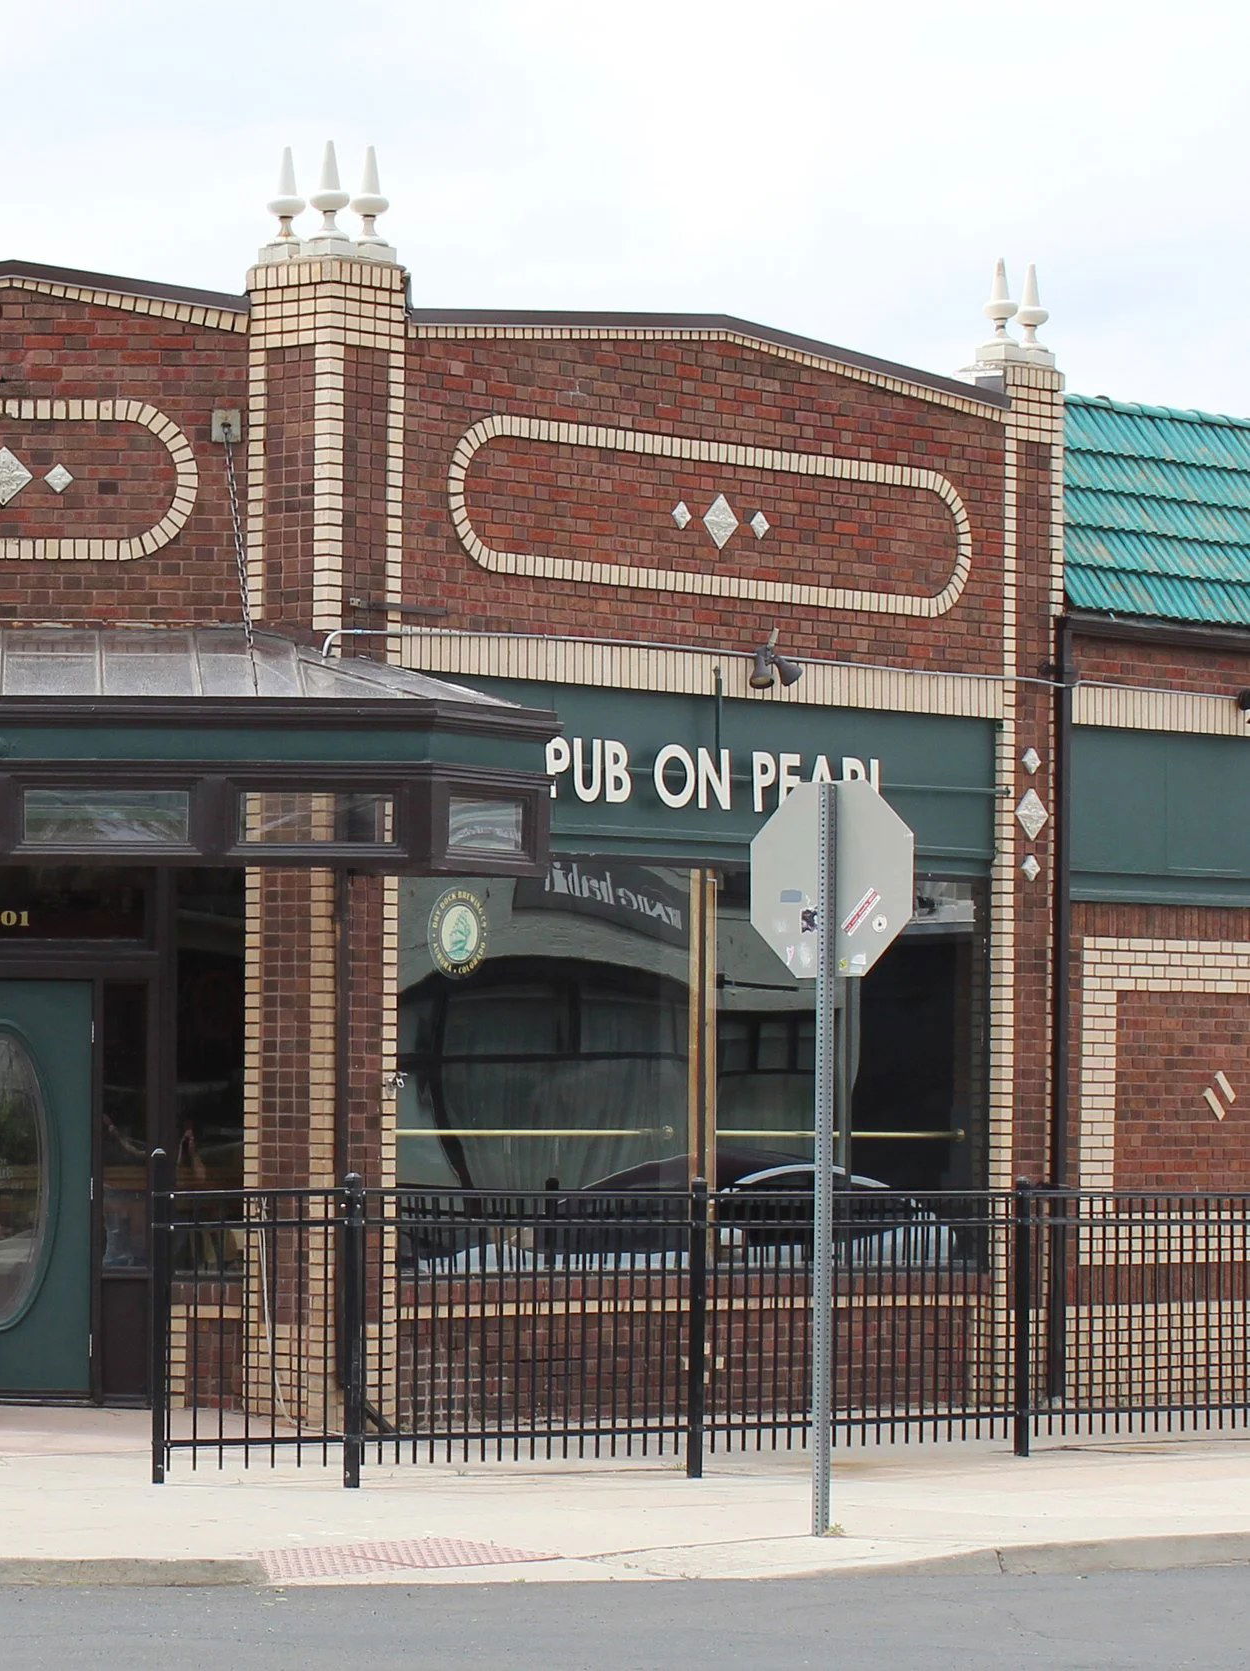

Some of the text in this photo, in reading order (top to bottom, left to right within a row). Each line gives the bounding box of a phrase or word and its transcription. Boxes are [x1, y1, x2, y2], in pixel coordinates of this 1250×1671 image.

[546, 736, 632, 803] PUB
[654, 743, 732, 810] ON
[439, 892, 457, 910] DOCK
[456, 890, 483, 915] BREWING
[432, 941, 486, 974] AURORA COLORADO
